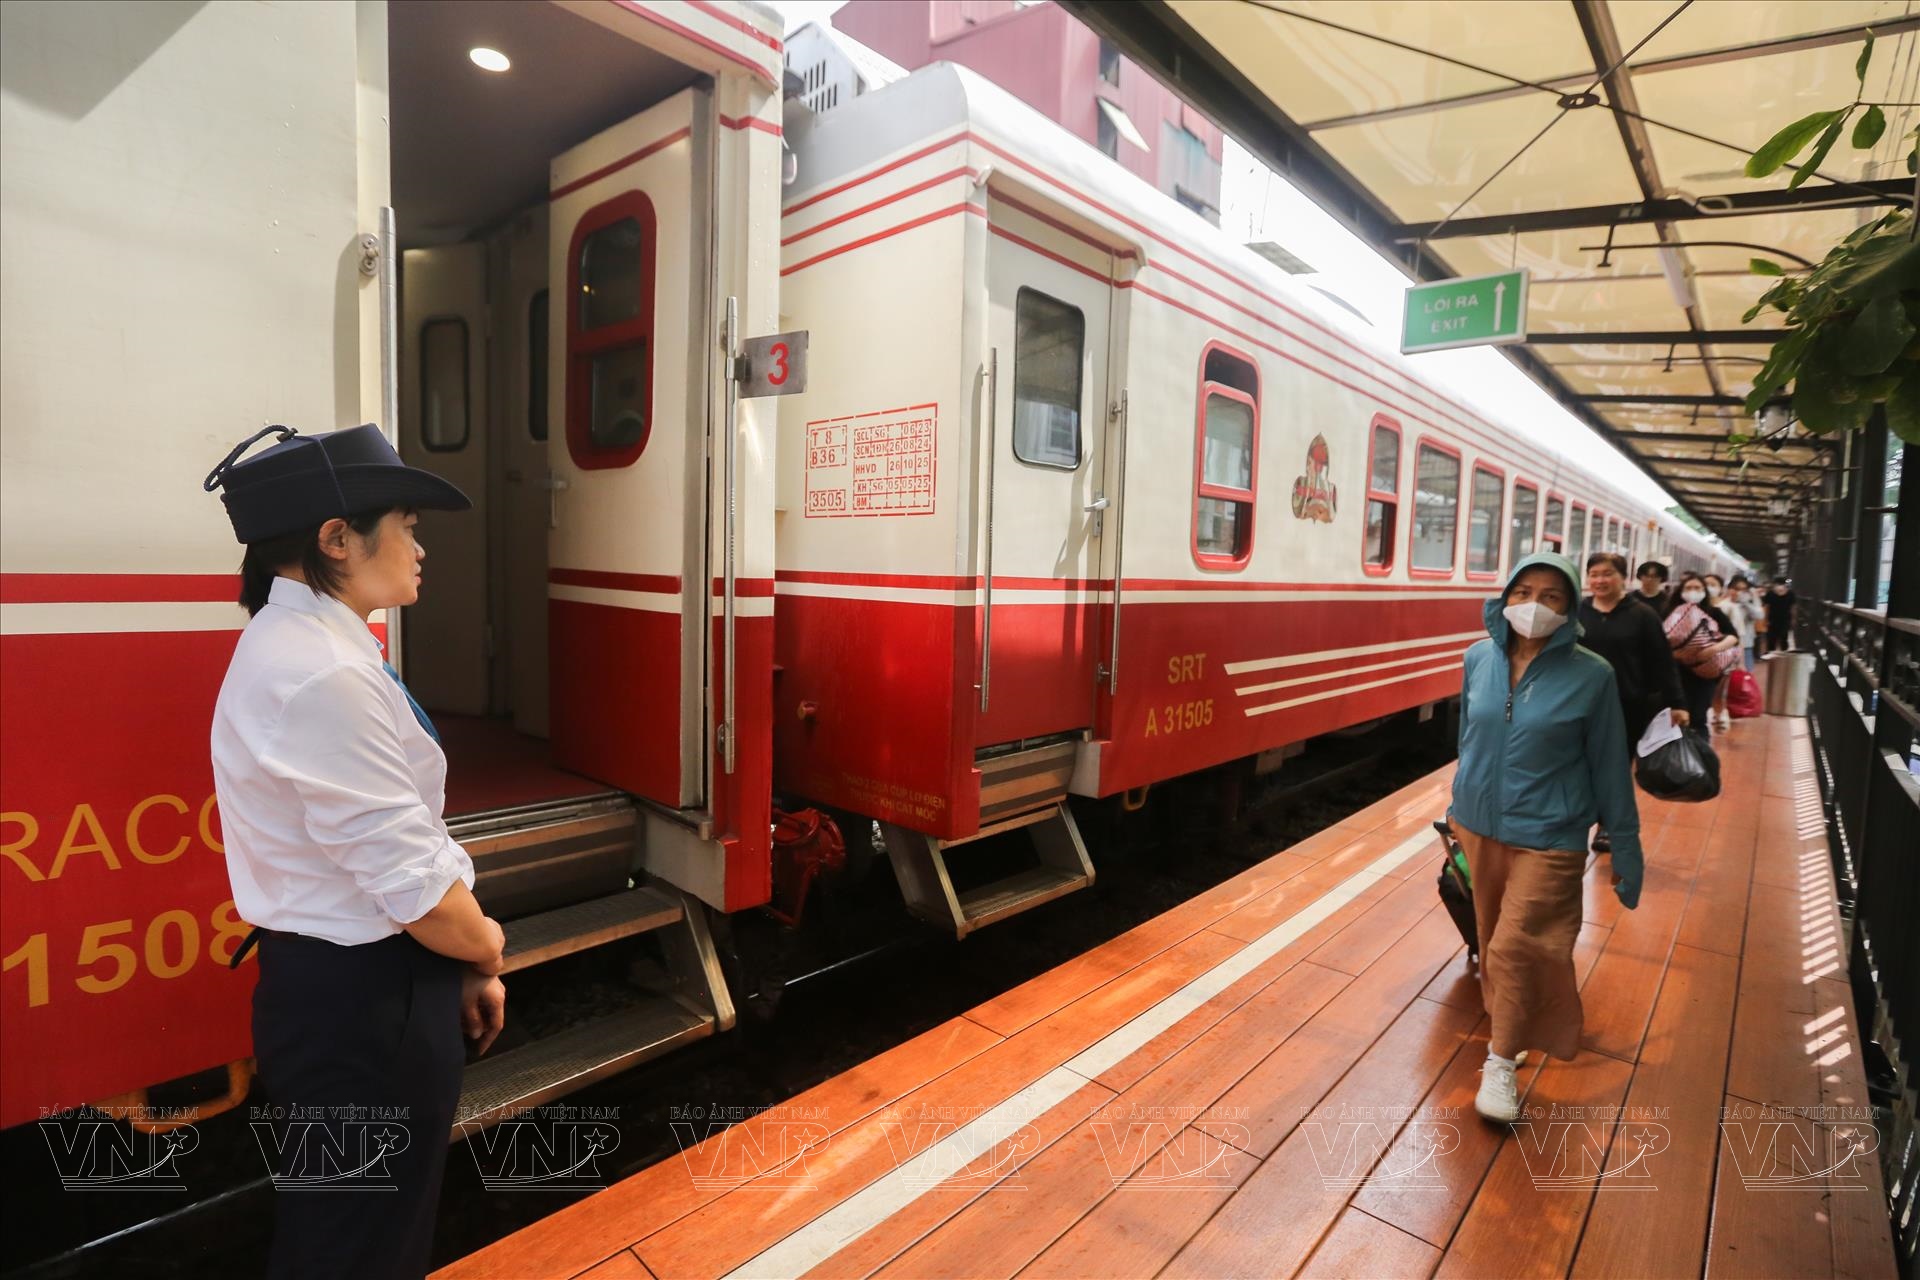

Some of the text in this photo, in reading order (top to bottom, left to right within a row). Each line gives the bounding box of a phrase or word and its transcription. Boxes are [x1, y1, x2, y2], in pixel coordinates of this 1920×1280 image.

[1455, 294, 1479, 309] RA
[1431, 316, 1468, 333] EXIT
[768, 341, 789, 385] 3
[812, 432, 818, 446] T
[825, 430, 832, 445] 8
[856, 422, 930, 441] SCL SG 06 23
[856, 445, 870, 456] SCN
[890, 441, 900, 452] 26
[903, 440, 914, 450] 08
[917, 438, 929, 449] 24
[890, 460, 900, 471] 26
[904, 459, 913, 469] 10
[917, 457, 929, 468] 25
[872, 481, 884, 491] SG
[888, 480, 900, 490] 05
[902, 480, 913, 489] 05
[917, 478, 929, 488] 25
[813, 492, 842, 507] 3505
[856, 497, 867, 507] BM
[1168, 653, 1207, 684] SRT
[1144, 699, 1214, 738] A 31505
